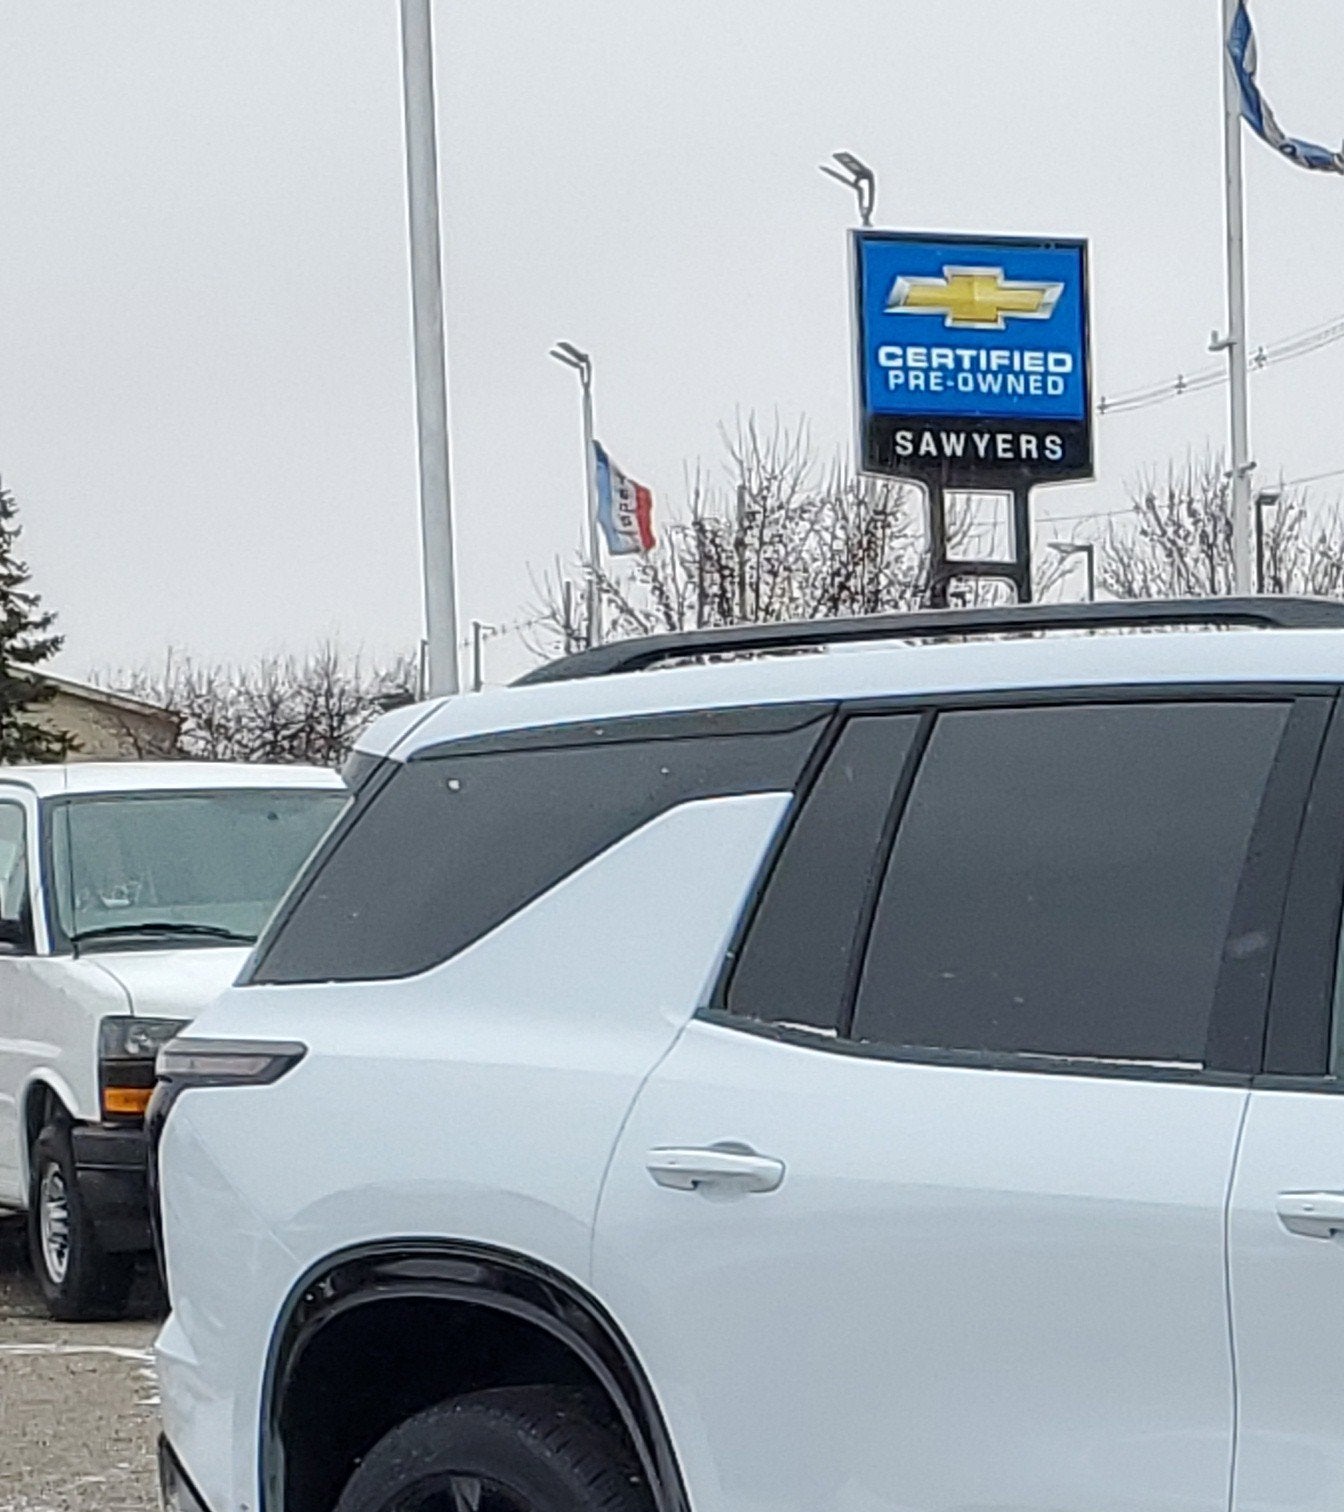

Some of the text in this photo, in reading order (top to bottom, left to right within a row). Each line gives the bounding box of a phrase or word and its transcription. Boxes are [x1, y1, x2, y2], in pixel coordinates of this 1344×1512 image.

[878, 345, 1073, 373] CERTIFIED
[888, 370, 1065, 395] PRE-OWNED
[894, 431, 1063, 461] SAWYERS
